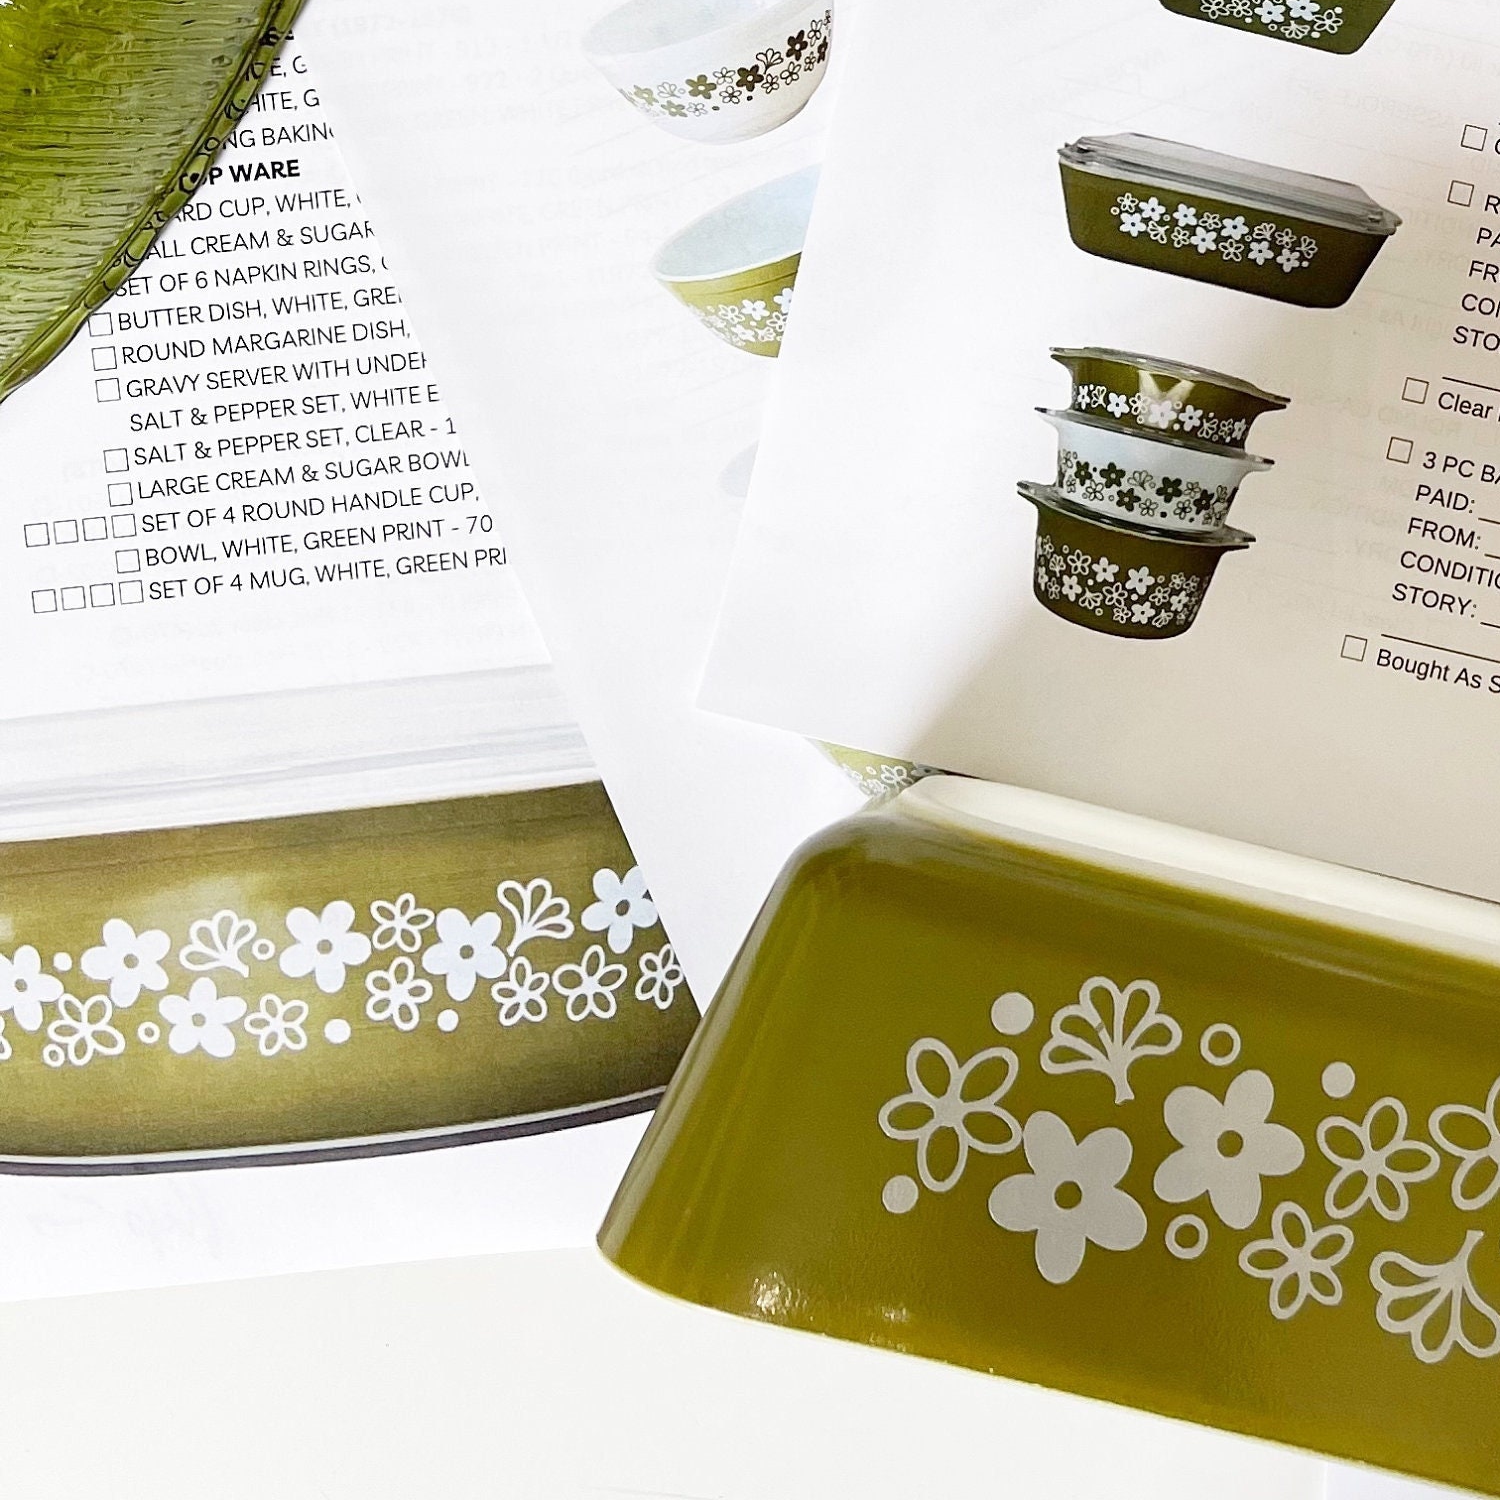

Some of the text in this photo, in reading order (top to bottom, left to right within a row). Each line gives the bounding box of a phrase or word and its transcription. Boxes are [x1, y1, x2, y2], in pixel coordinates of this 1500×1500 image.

[228, 157, 302, 184] WARE
[219, 188, 351, 219] CUP, WHITE,
[190, 228, 295, 256] CREAM &
[159, 271, 190, 294] OF
[195, 270, 210, 291] 6
[214, 261, 299, 289] NAPKIN
[302, 254, 377, 280] RINGS,
[117, 291, 348, 332] BUTTER DISH, WHITE,
[121, 318, 411, 365] ROUND MARGARINE DISH,
[126, 358, 350, 398] GRAVY SERVER WITH
[130, 385, 422, 432] SALT & PEPPER SET, WHITE
[1437, 391, 1494, 420] Clear
[134, 419, 426, 466] SALT & PEPPER SET, CLEAR
[137, 455, 404, 500] LARGE CREAM & SUGAR
[1422, 451, 1437, 470] 3
[1441, 454, 1476, 478] PC
[141, 482, 479, 533] SET OF 4 ROUND HANDLE CUP,
[1414, 483, 1476, 514] PAID:
[145, 518, 445, 567] BOWL, WHITE, GREEN PRINT
[1407, 516, 1482, 551] FROM:
[149, 550, 469, 600] SET OF 4 MUG, WHITE, GREEN
[1391, 582, 1477, 619] STORY:
[1376, 648, 1451, 683] Bought
[1453, 667, 1483, 690] As
